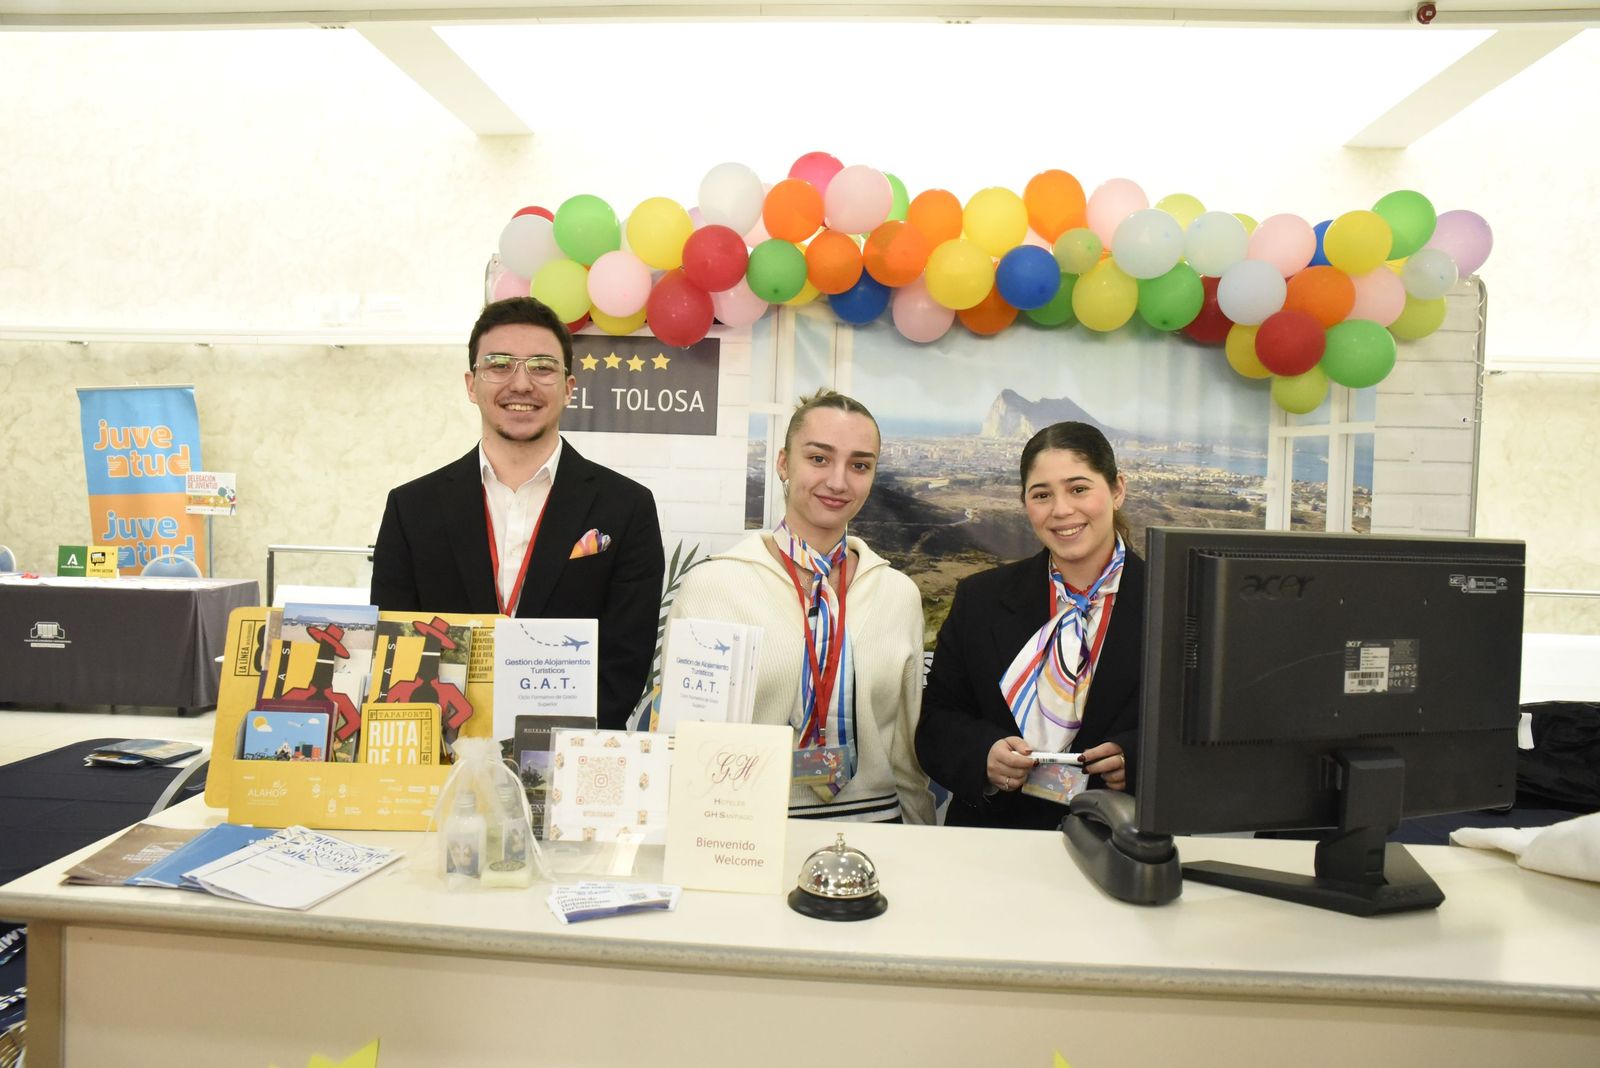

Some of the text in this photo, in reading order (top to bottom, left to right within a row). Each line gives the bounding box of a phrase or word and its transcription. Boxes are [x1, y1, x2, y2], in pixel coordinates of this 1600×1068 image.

[611, 387, 705, 413] TOLOSA
[94, 419, 174, 450] juve
[107, 444, 191, 478] ntud
[103, 510, 179, 541] juve
[1240, 574, 1316, 600] acer
[238, 664, 248, 673] LA
[533, 658, 543, 666] de
[544, 658, 591, 667] Alojamientos
[369, 720, 418, 747] RUTA
[696, 836, 756, 851] Bienvenido
[714, 853, 764, 868] Welcome
